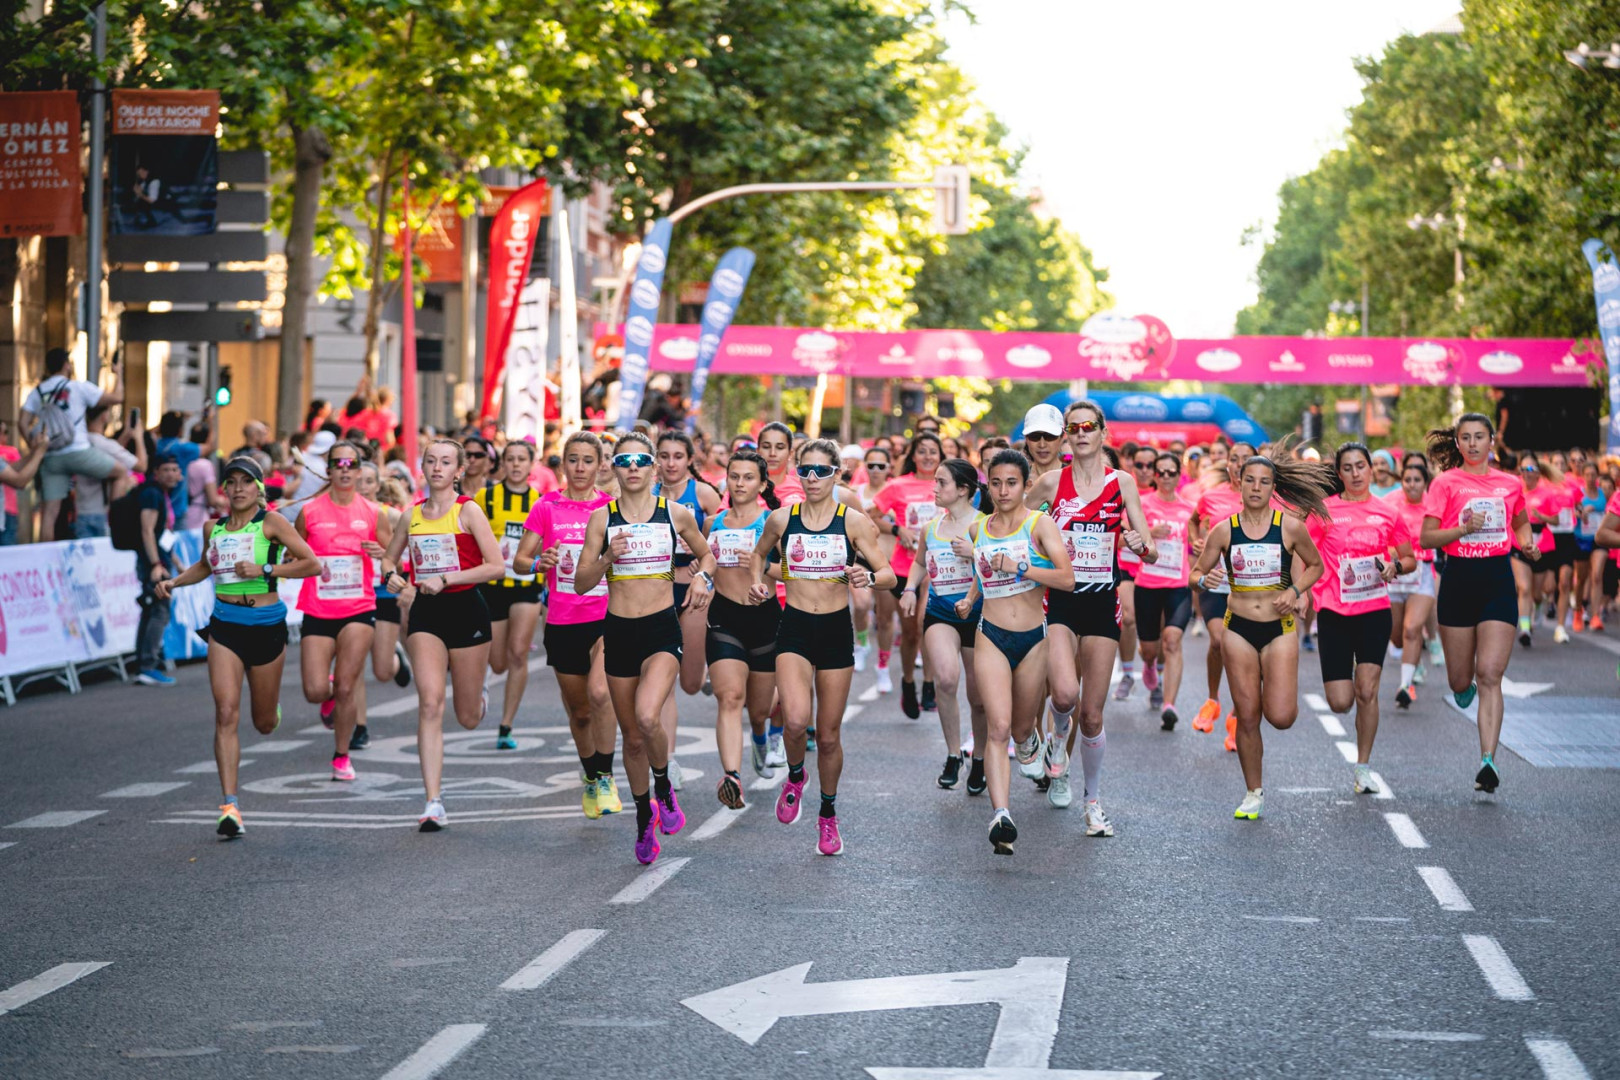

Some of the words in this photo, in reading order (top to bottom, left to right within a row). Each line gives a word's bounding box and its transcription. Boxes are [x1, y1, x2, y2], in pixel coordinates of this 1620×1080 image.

[118, 105, 145, 117] QUE
[147, 105, 163, 117] DE
[166, 105, 211, 117] NOCHE
[117, 117, 136, 129] LO
[137, 117, 202, 130] MATARON
[1085, 523, 1105, 533] BM
[631, 541, 652, 550] 016
[221, 553, 237, 561] 016
[424, 553, 441, 561] 016
[807, 550, 827, 559] 016
[1077, 551, 1097, 560] 016
